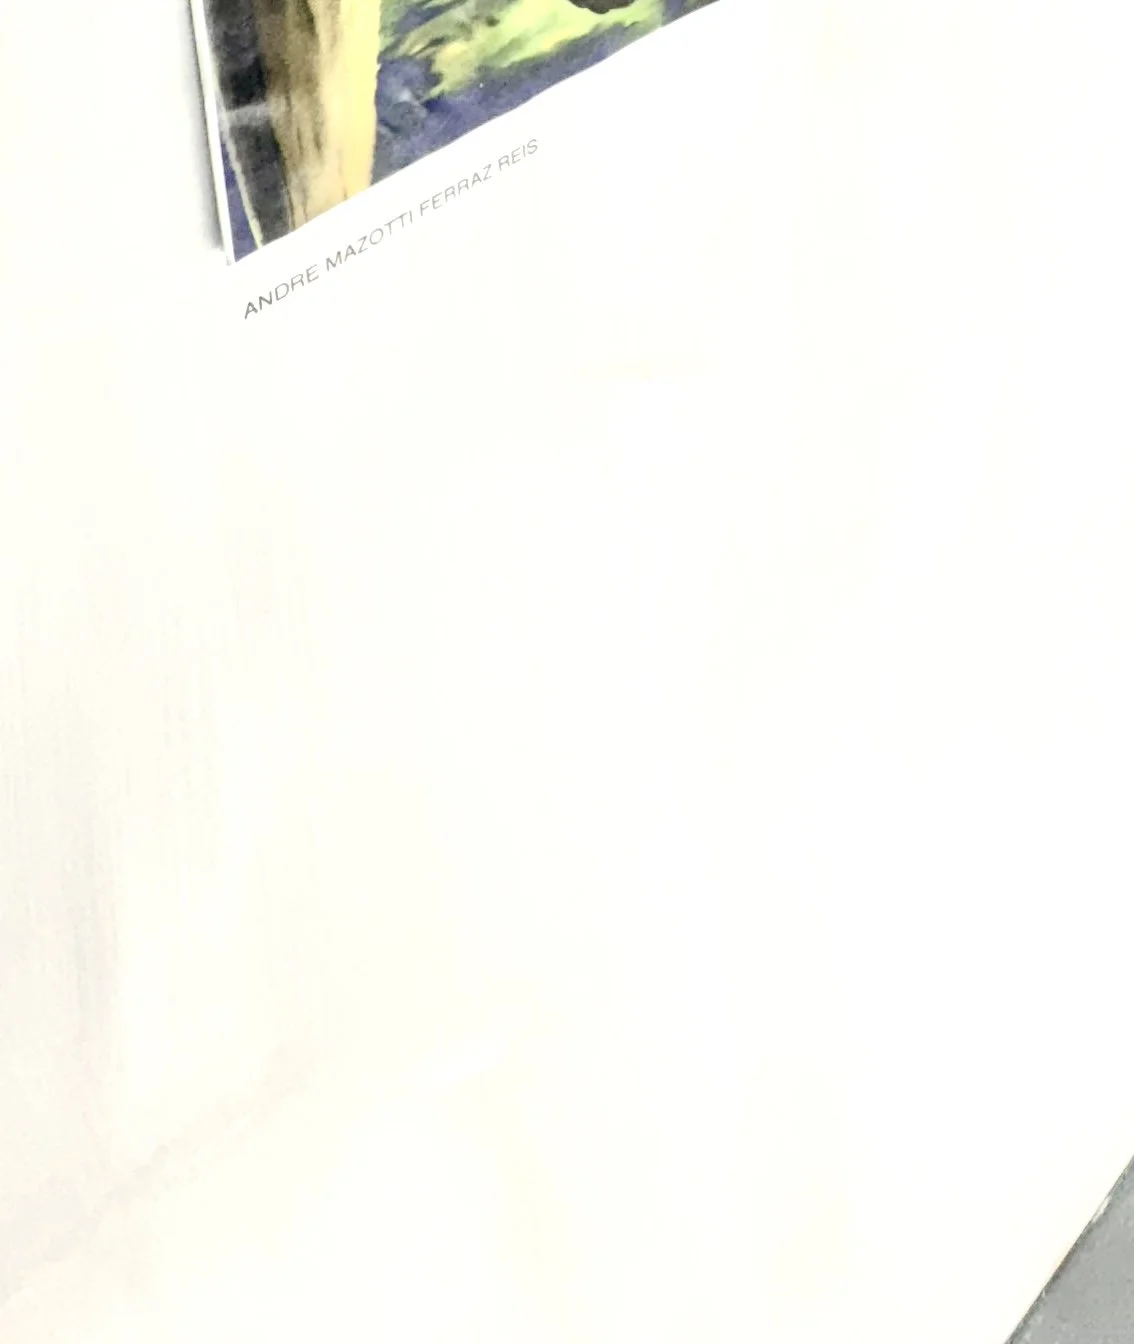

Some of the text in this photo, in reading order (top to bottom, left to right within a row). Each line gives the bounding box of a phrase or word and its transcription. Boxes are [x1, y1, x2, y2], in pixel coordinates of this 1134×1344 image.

[244, 138, 539, 320] ANDRE MAZOTTI FERRAZ REIS
